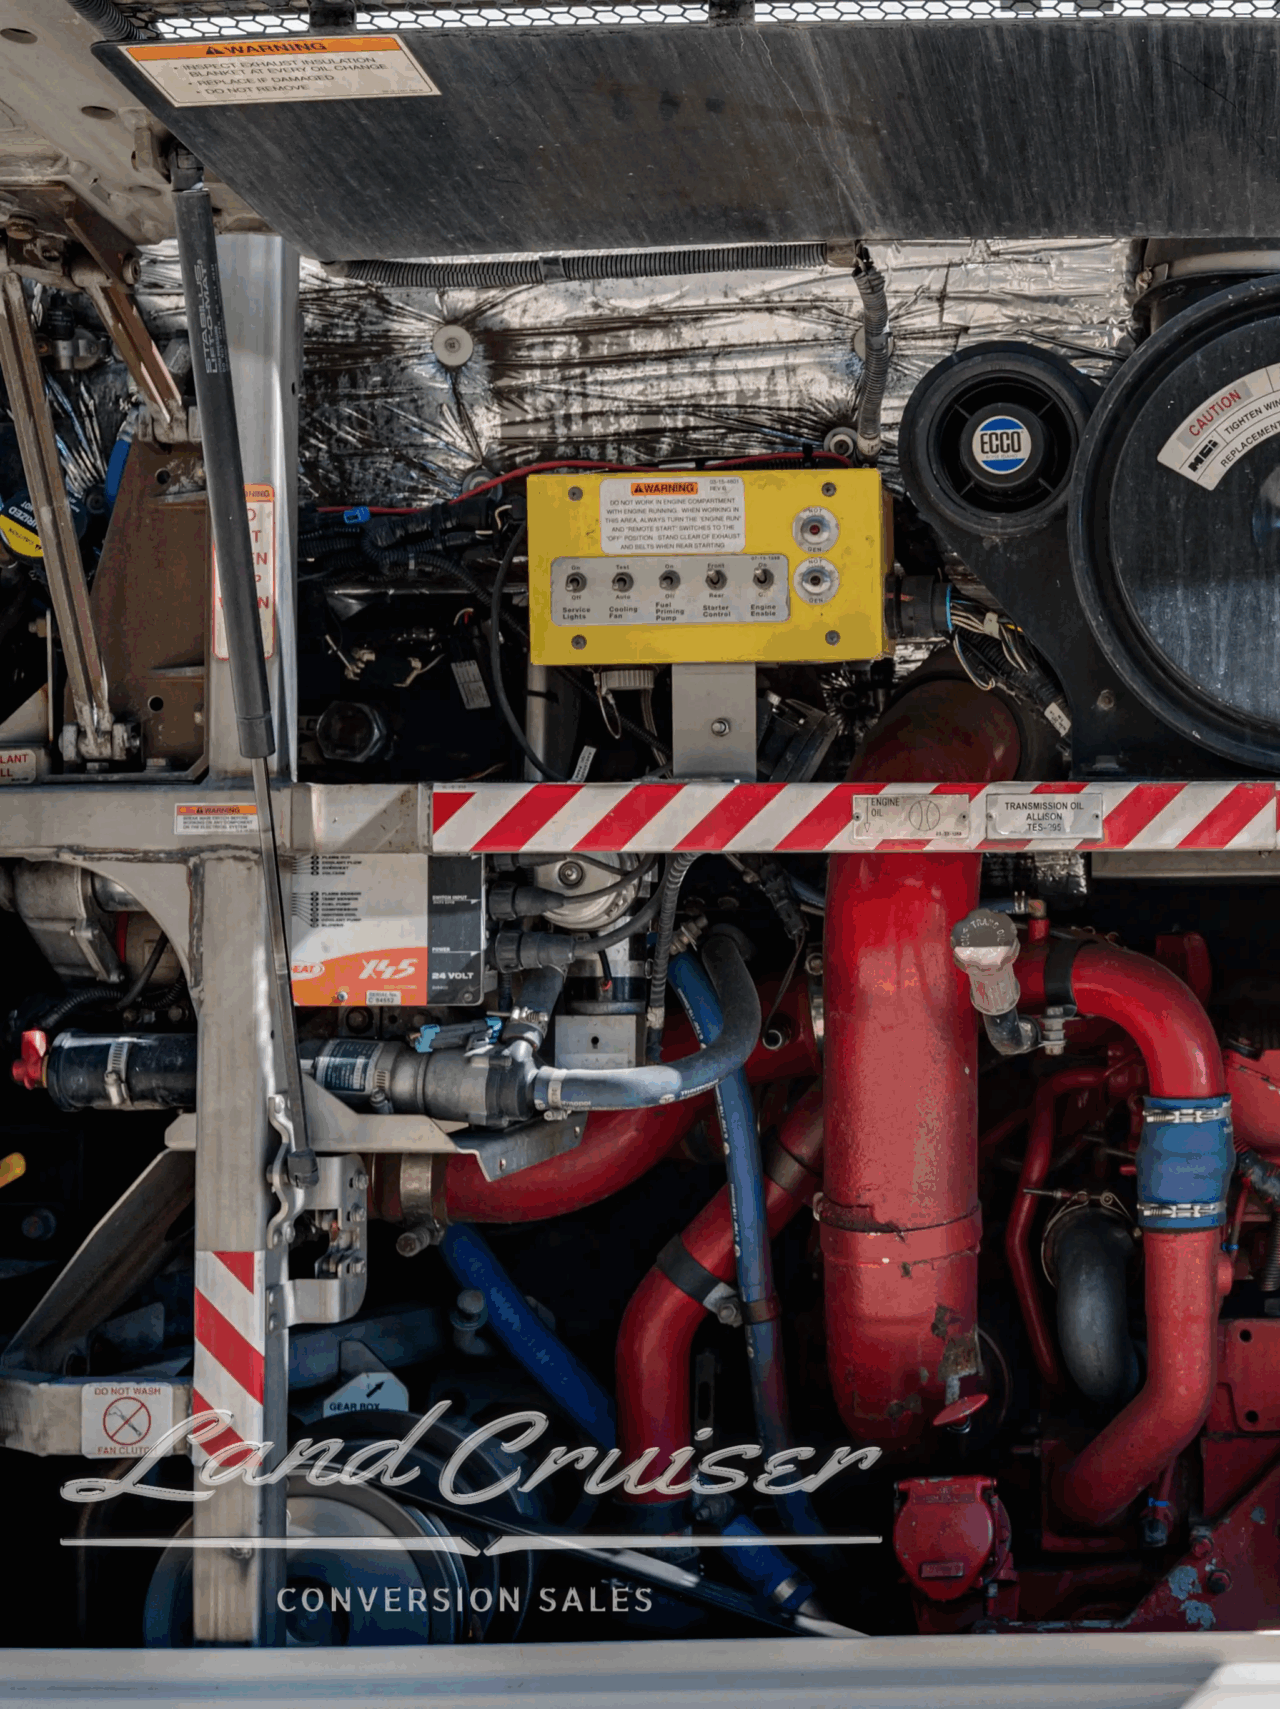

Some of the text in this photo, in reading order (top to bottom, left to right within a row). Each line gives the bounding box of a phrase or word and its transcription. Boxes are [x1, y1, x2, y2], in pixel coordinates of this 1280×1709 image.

[225, 43, 327, 54] WARNING
[183, 57, 376, 71] INSPECT EXHAUST INSULATION
[190, 69, 245, 78] BLANKET
[267, 66, 306, 74] EVERY
[334, 63, 388, 71] CHANGE
[197, 78, 253, 86] REPLACE
[272, 74, 334, 83] DAMAGED
[257, 84, 310, 92] REMOVE
[1189, 390, 1241, 436] CAUTION
[1224, 407, 1262, 435] TIGHTEN
[981, 431, 1021, 454] ECCO
[644, 483, 694, 493] WARNING
[871, 798, 900, 806] ENGINE
[1005, 802, 1084, 810] TRANSMISSION OIL
[871, 808, 883, 817] OIL
[358, 958, 419, 979] X45
[329, 1402, 357, 1411] GEAR
